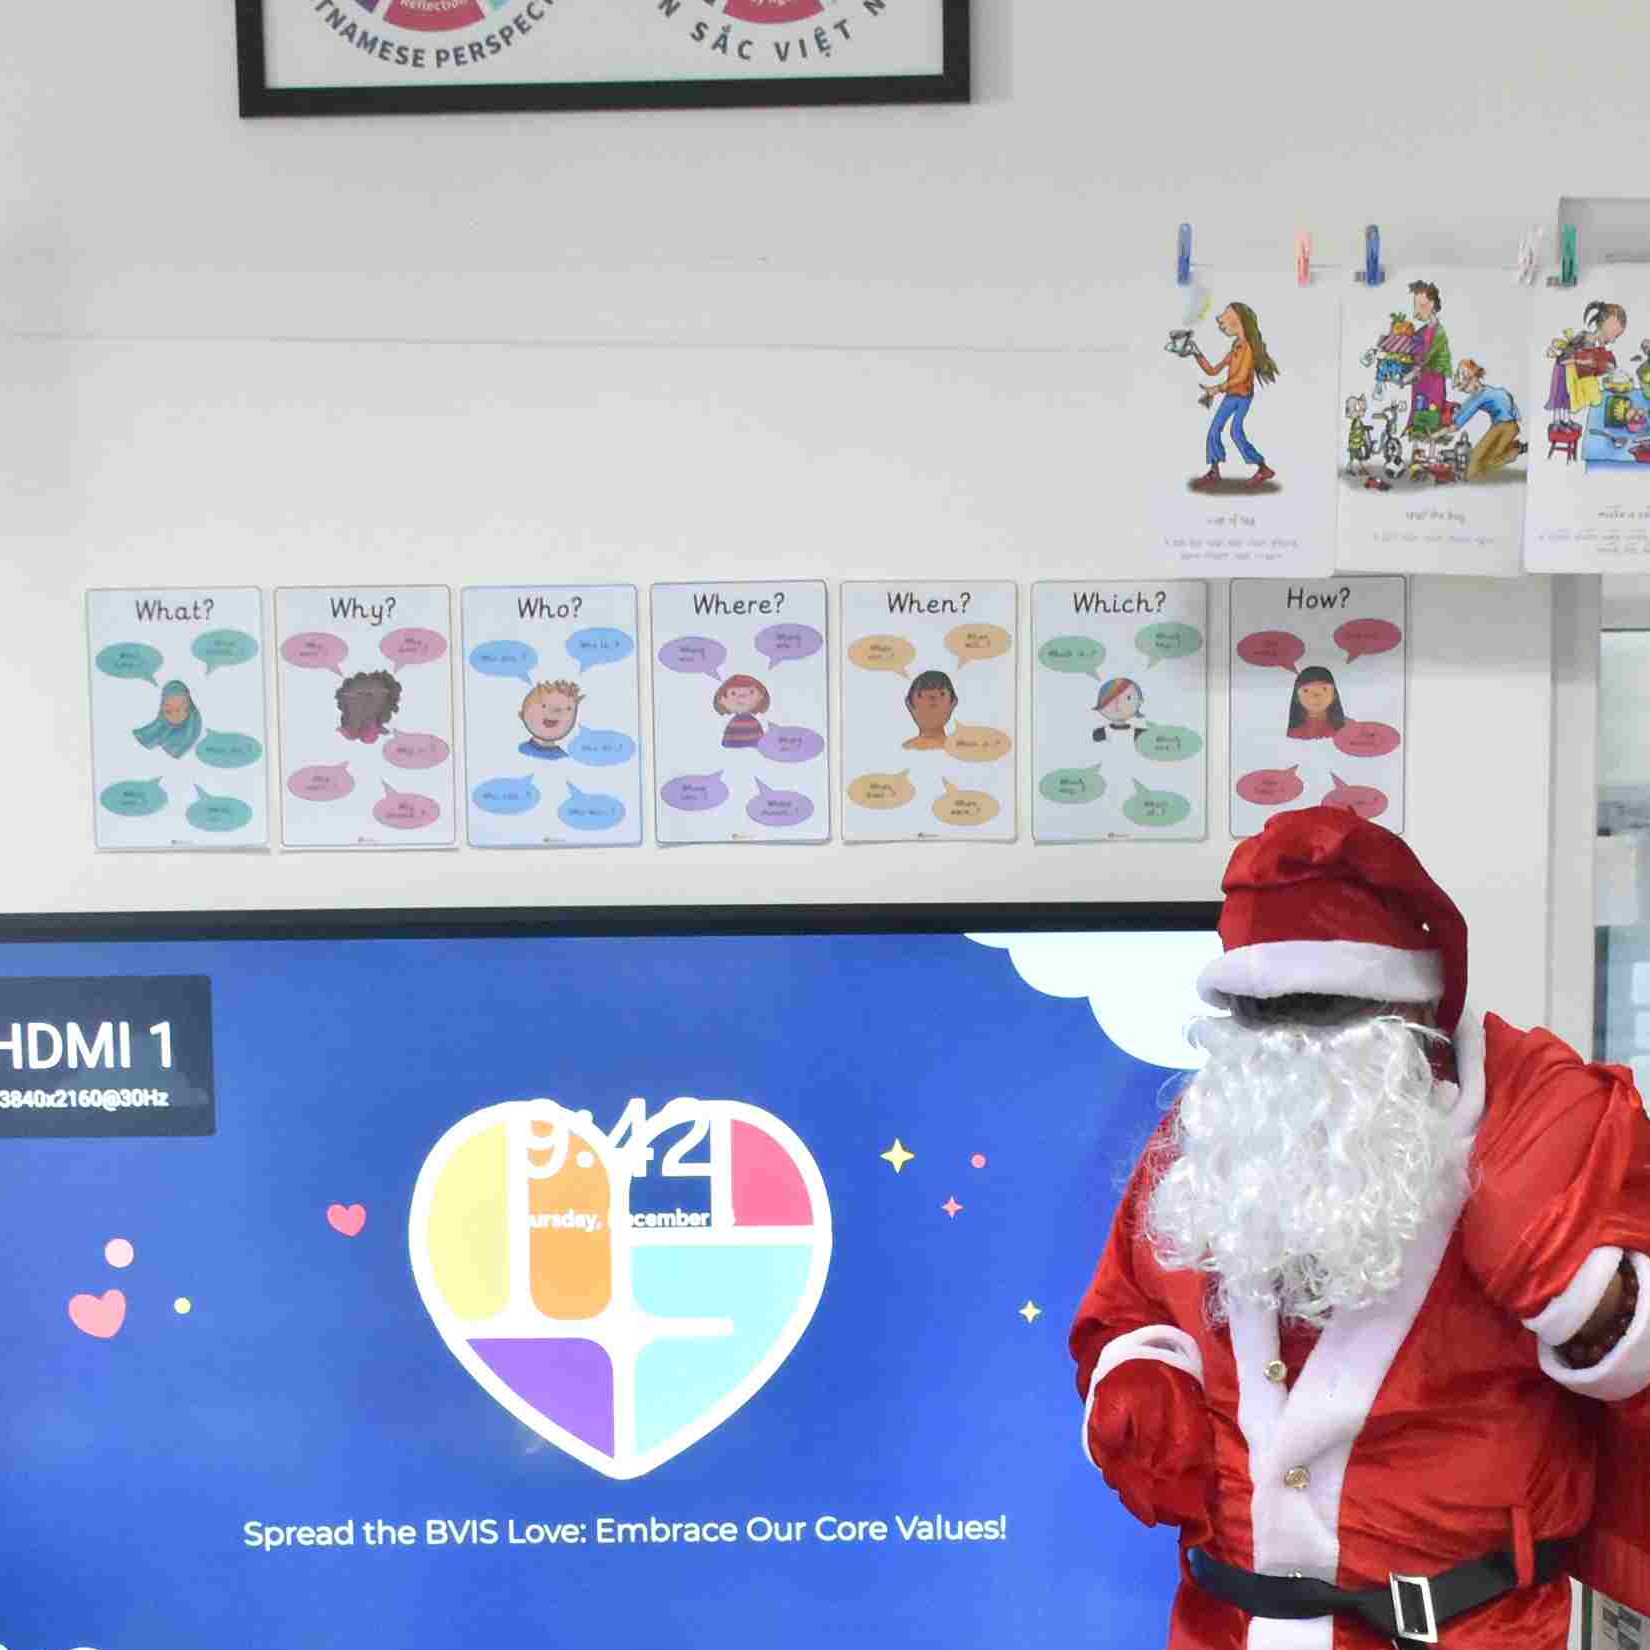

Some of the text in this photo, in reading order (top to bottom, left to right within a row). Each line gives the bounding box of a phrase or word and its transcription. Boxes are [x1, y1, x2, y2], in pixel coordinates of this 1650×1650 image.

[517, 596, 583, 620] Who?
[693, 593, 785, 616] Where?
[886, 592, 972, 615] When?
[1073, 591, 1167, 615] Which?
[1286, 586, 1351, 609] How?
[134, 599, 215, 622] What?
[330, 597, 397, 626] Why?
[149, 1021, 174, 1068] 1
[242, 1513, 1008, 1551] Spread the BVIS Love: Embrace Our Core Values!
